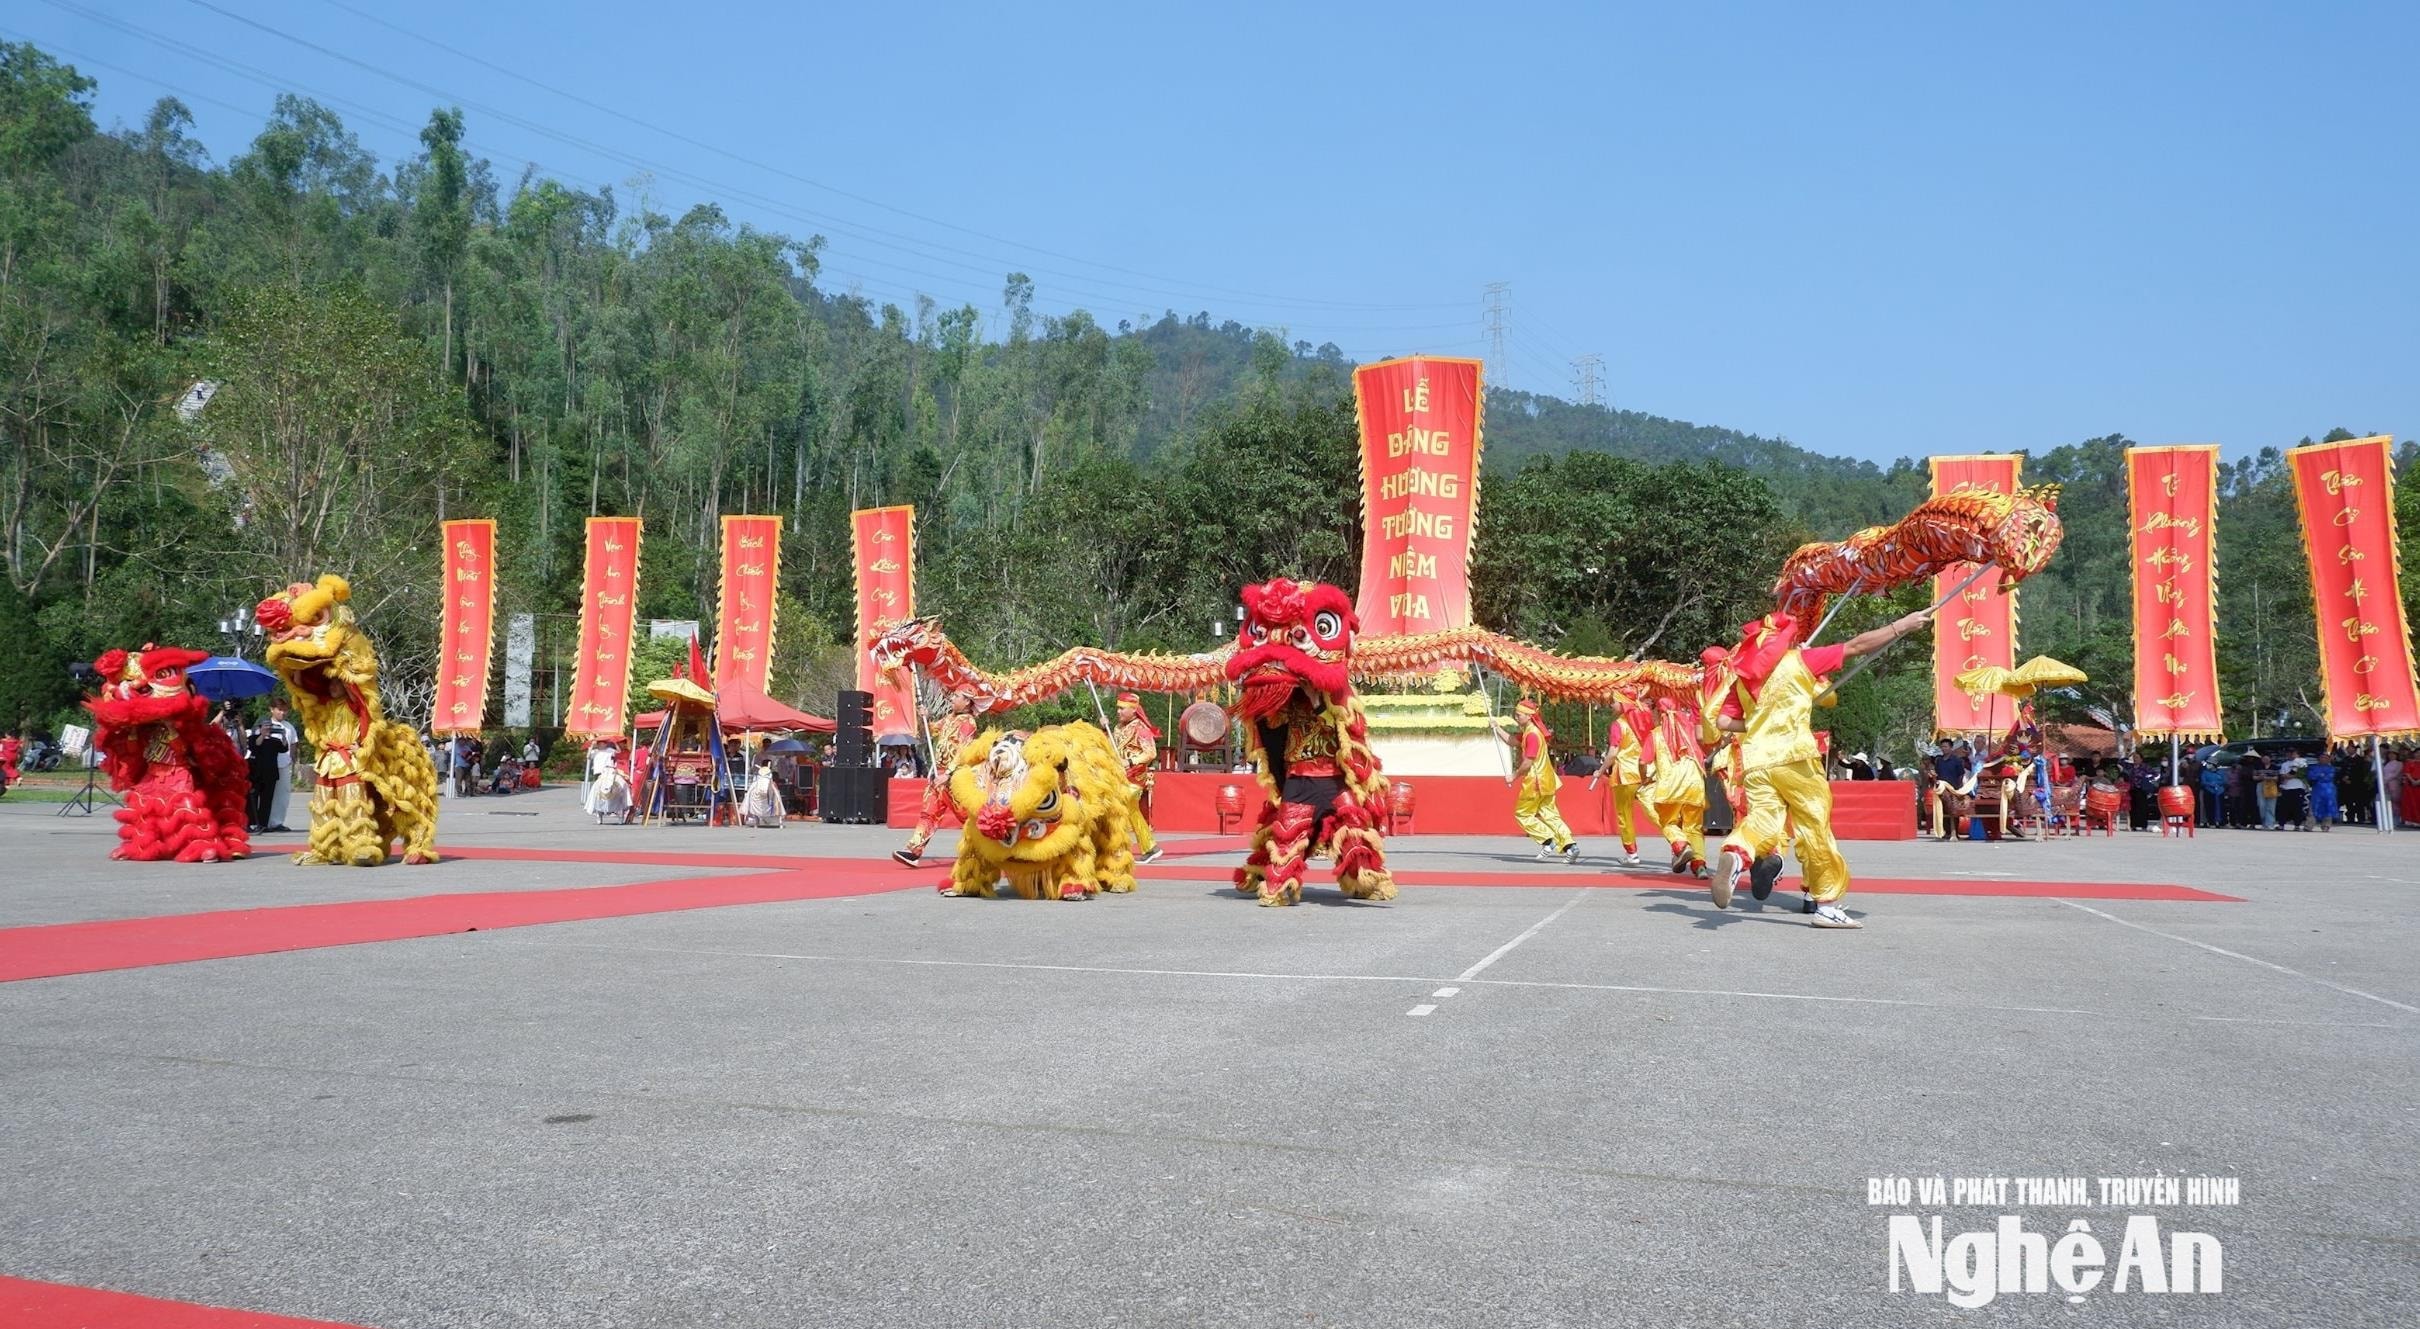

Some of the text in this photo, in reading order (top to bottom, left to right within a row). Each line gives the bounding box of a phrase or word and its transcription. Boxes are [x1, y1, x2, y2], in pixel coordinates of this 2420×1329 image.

[2320, 470, 2364, 495] Thiên
[1381, 377, 1458, 619] LỄ DÂNG HƯƠNG TƯỞNG NIỆM VUA
[2137, 511, 2205, 538] Phương
[1957, 618, 1992, 642] Thiên
[2341, 617, 2379, 642] Thiên
